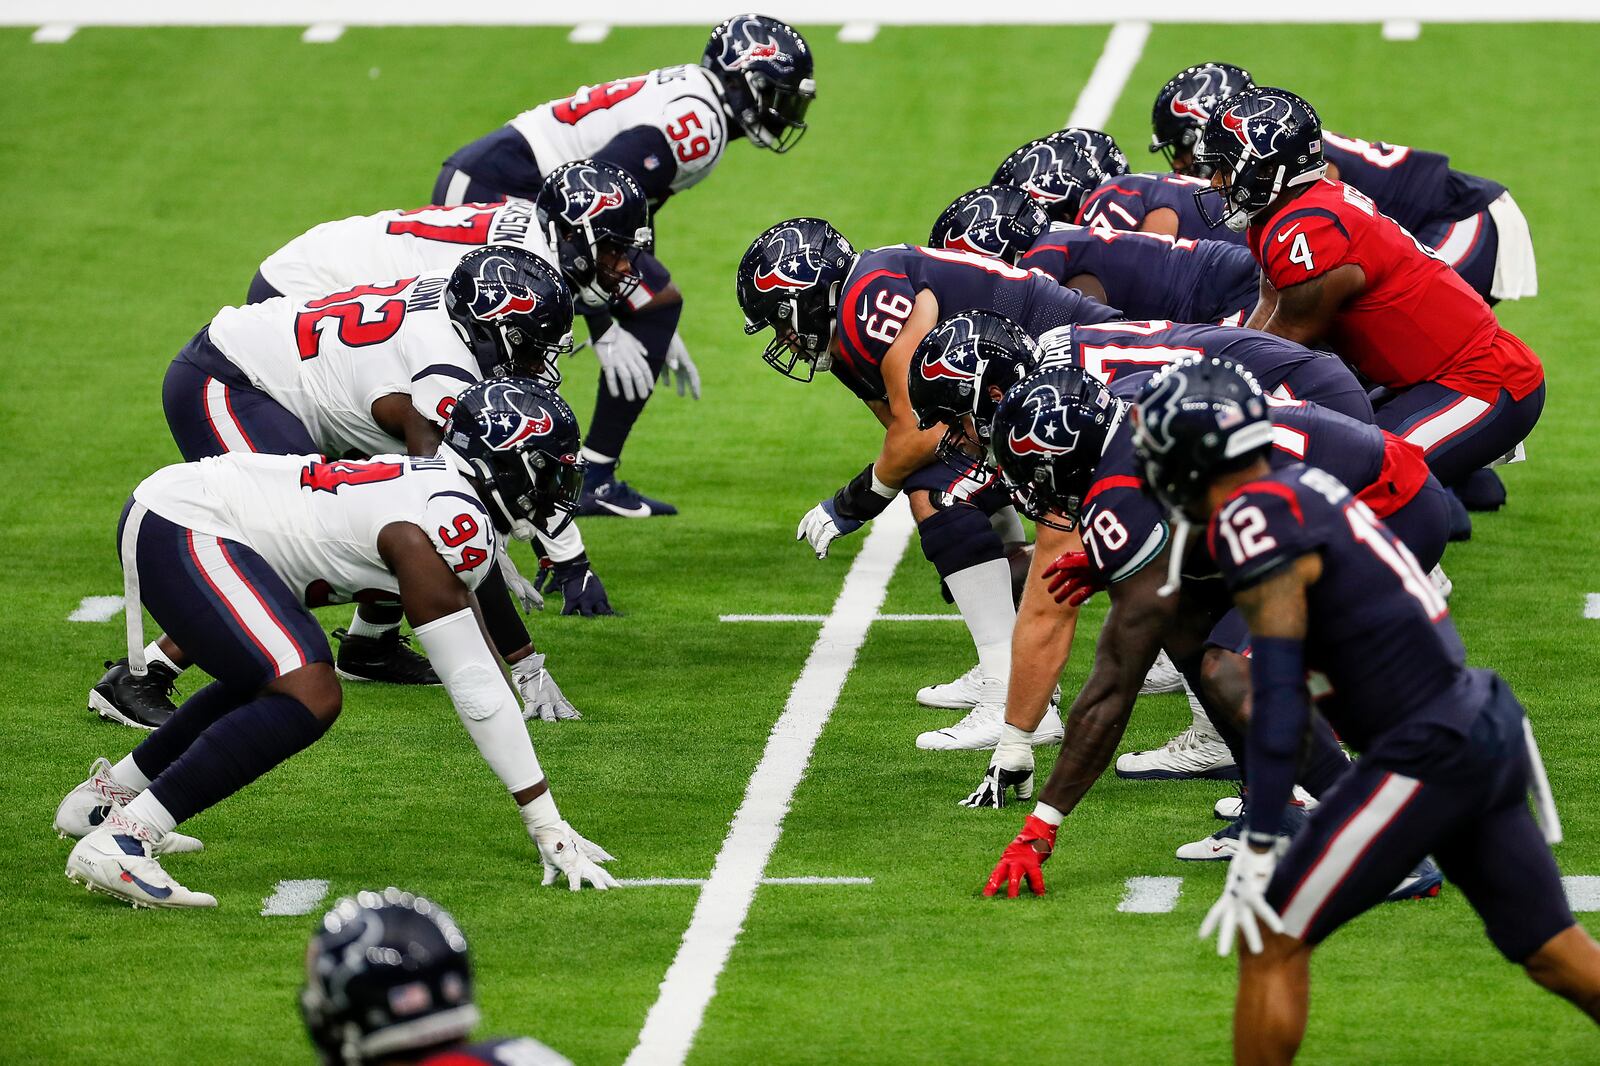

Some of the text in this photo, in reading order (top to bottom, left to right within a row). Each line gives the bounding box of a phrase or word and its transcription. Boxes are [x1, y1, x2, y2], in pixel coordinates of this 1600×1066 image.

[666, 111, 710, 163] 59
[1289, 232, 1315, 271] 4
[407, 277, 449, 313] DUNN
[866, 289, 913, 344] 66
[438, 513, 488, 573] 94
[1081, 508, 1129, 570] 78
[1218, 505, 1278, 567] 12
